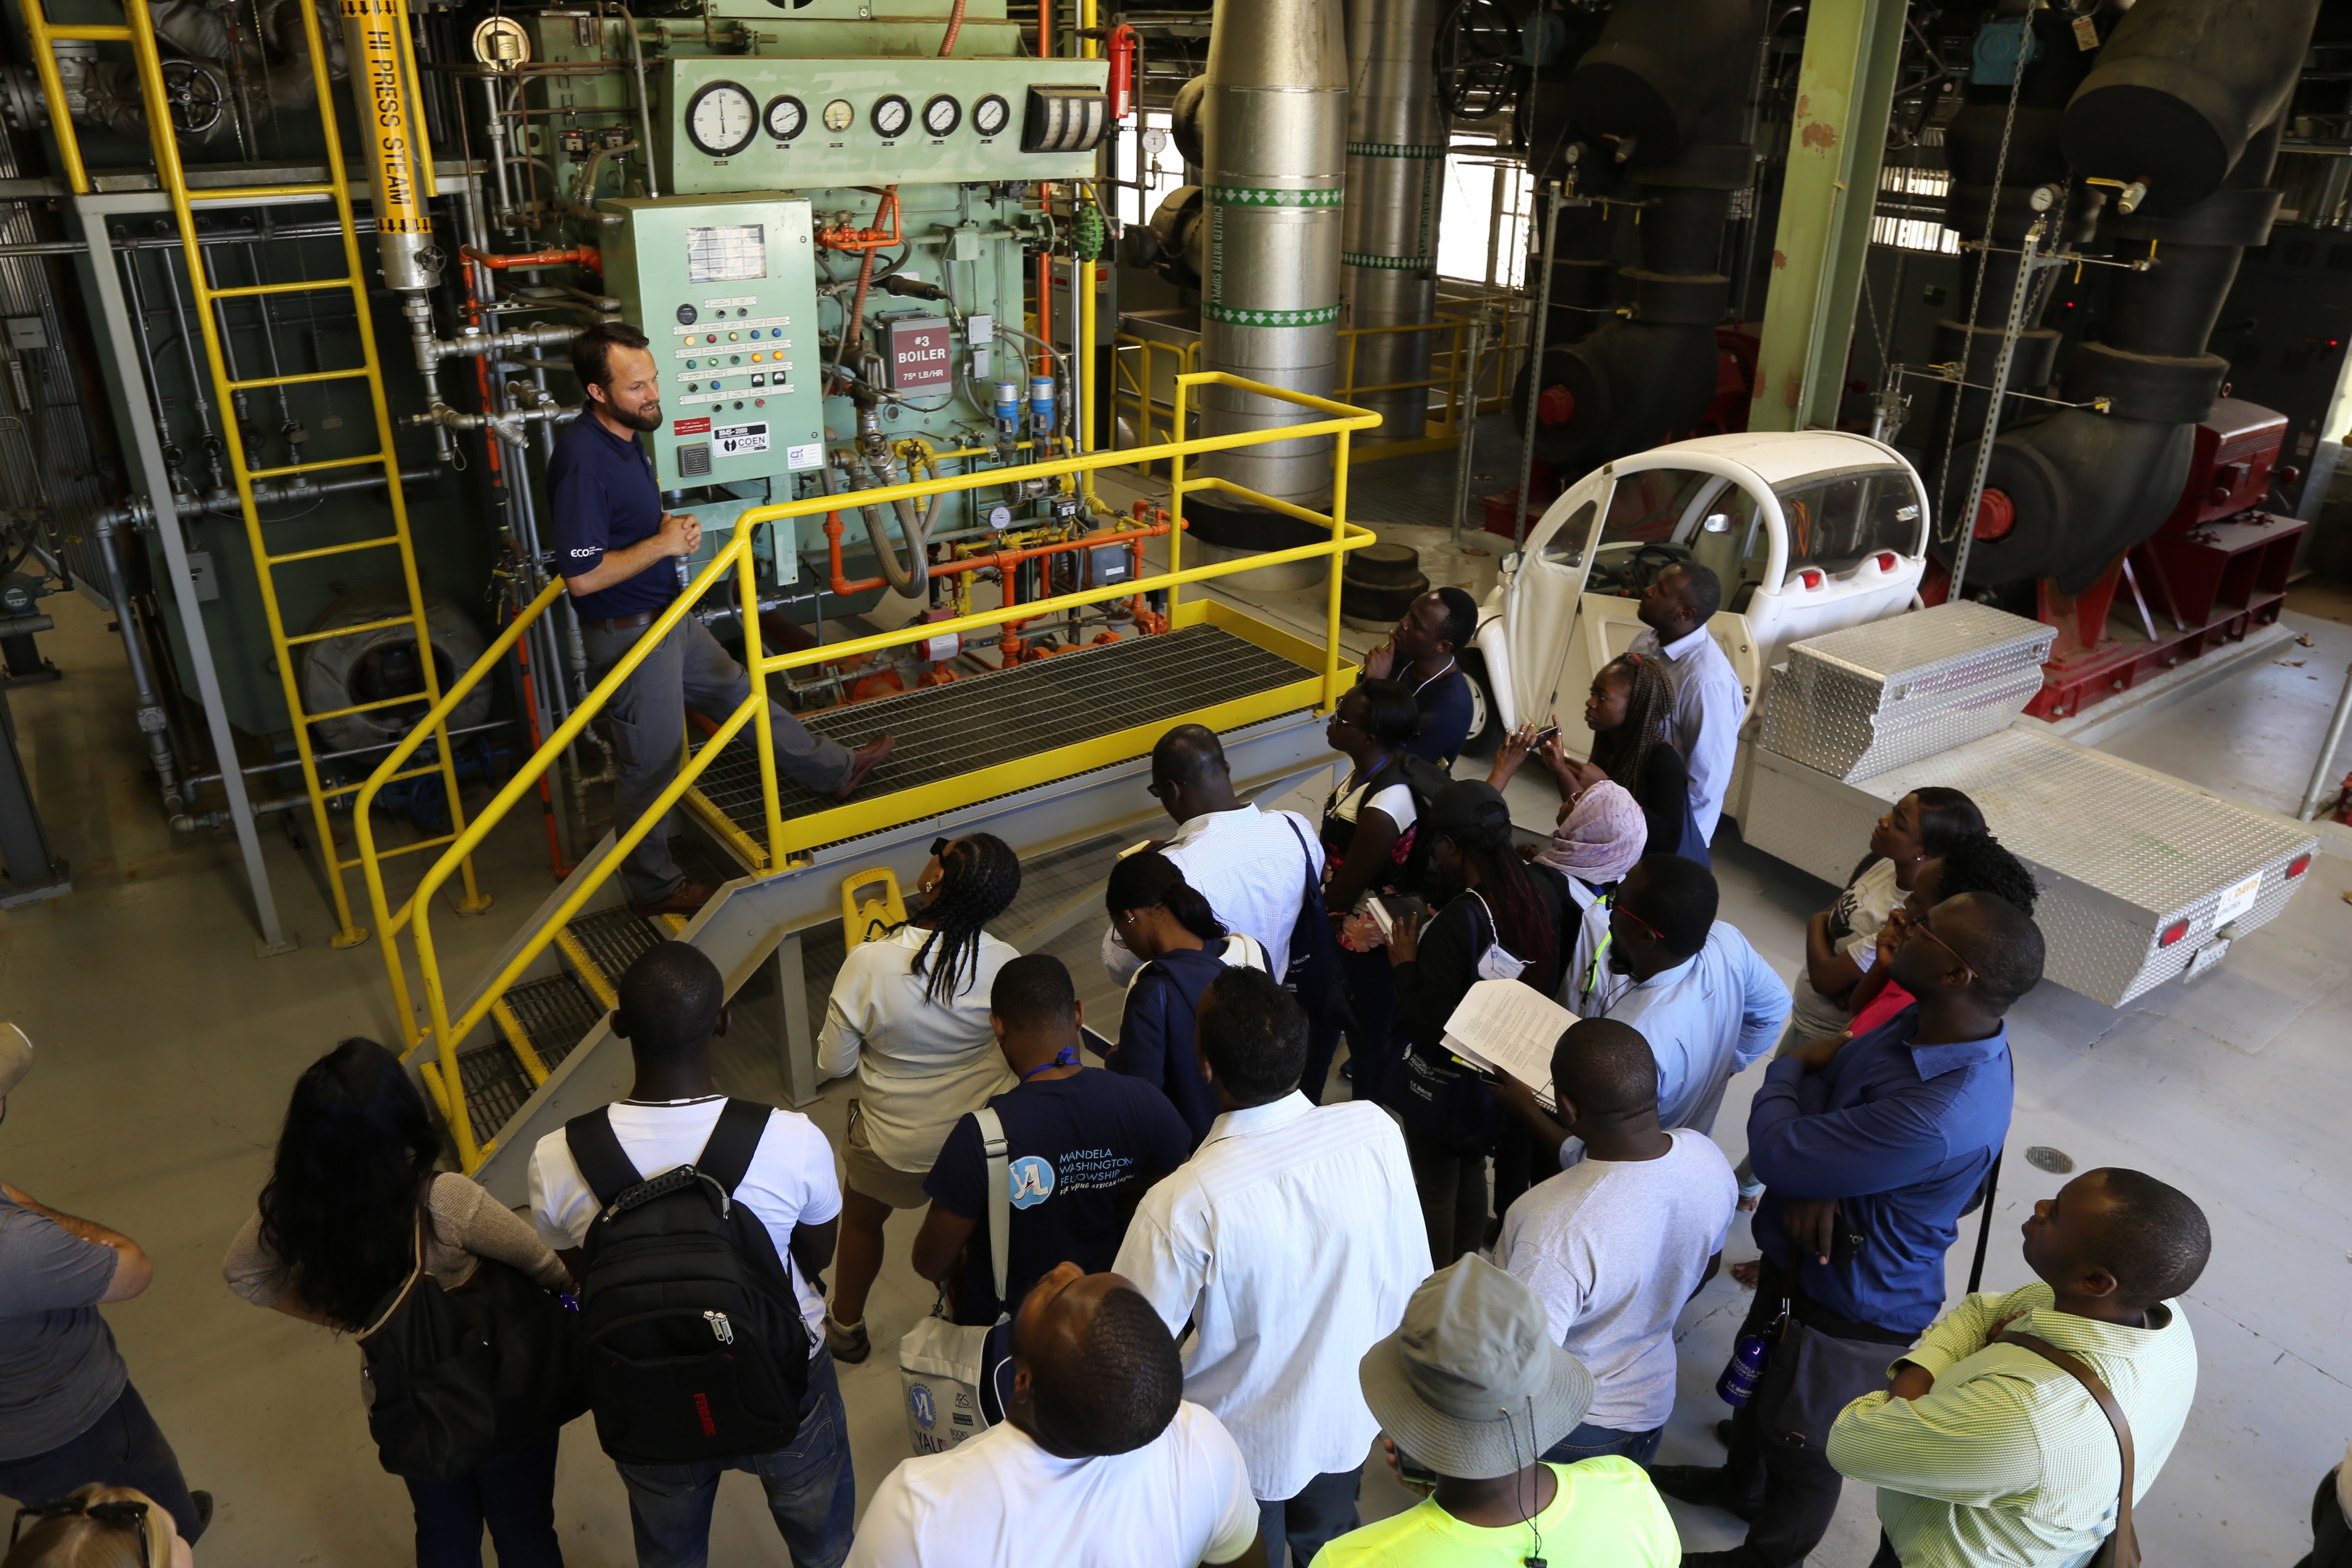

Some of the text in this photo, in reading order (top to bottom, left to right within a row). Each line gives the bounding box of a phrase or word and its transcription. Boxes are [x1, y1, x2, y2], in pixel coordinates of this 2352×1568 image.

[367, 31, 411, 205] HI PRESS STEAM
[1212, 206, 1223, 304] CHILLED WATER SUPPLY
[914, 336, 930, 347] #3
[898, 348, 946, 364] BOILER
[919, 369, 944, 379] LB/HR
[718, 427, 748, 436] BMS-2000
[739, 436, 765, 446] COEN
[1059, 1148, 1113, 1163] MANDELA
[1059, 1157, 1133, 1174] WASHINGTON
[1060, 1169, 1120, 1187] FELOWSHIP
[1091, 1180, 1116, 1189] AFRICAN
[955, 1393, 969, 1406] ARS
[950, 1428, 969, 1438] BOOKS
[914, 1430, 943, 1454] YALI
